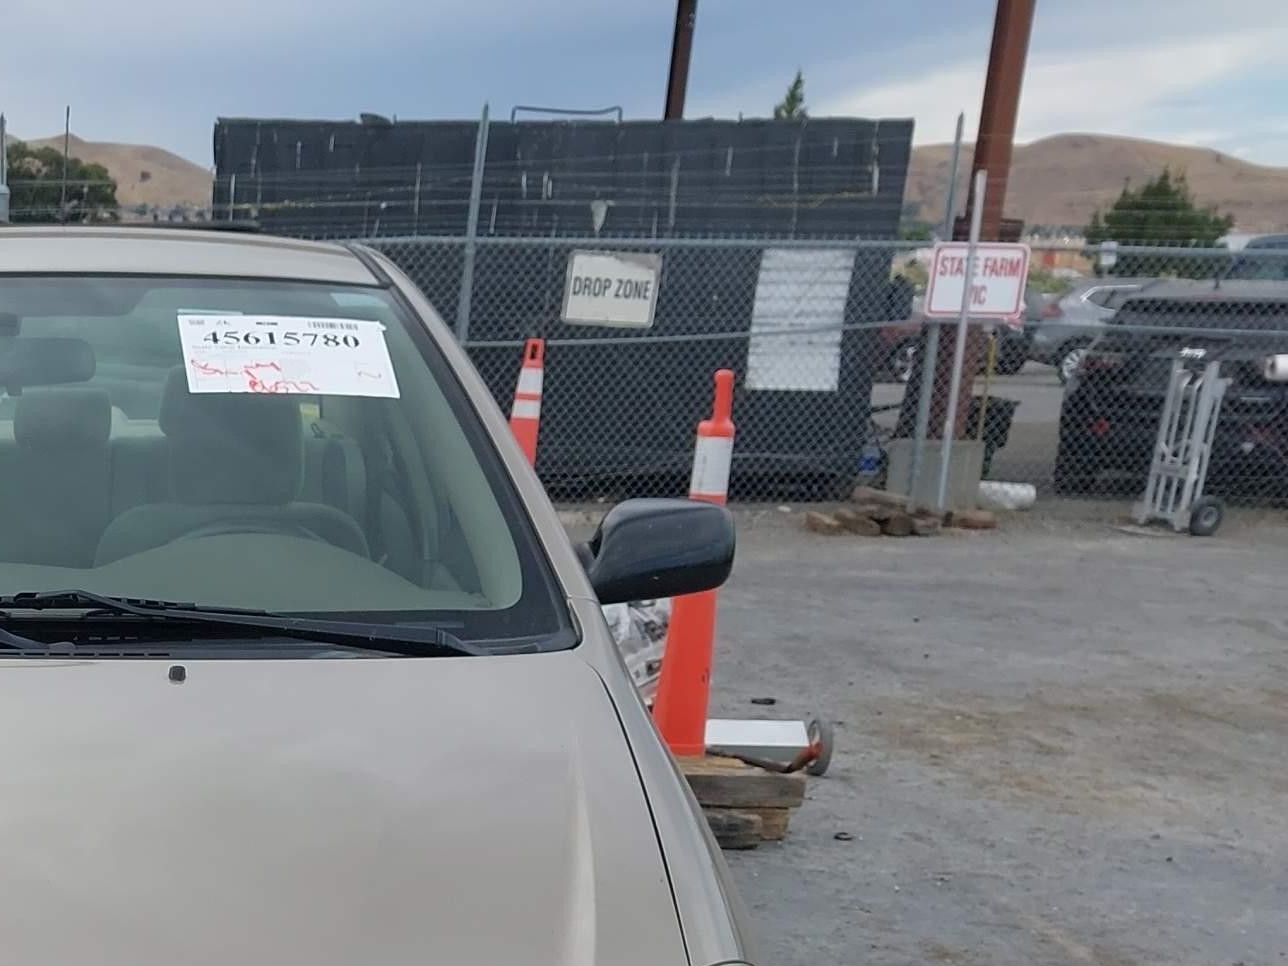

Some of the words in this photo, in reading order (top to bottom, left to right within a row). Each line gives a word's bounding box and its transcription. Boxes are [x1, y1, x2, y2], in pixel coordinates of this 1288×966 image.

[939, 256, 980, 277] STAE
[983, 257, 1021, 278] FARM
[572, 276, 612, 297] DROP
[614, 278, 651, 300] ZONE
[203, 330, 361, 349] 45615780
